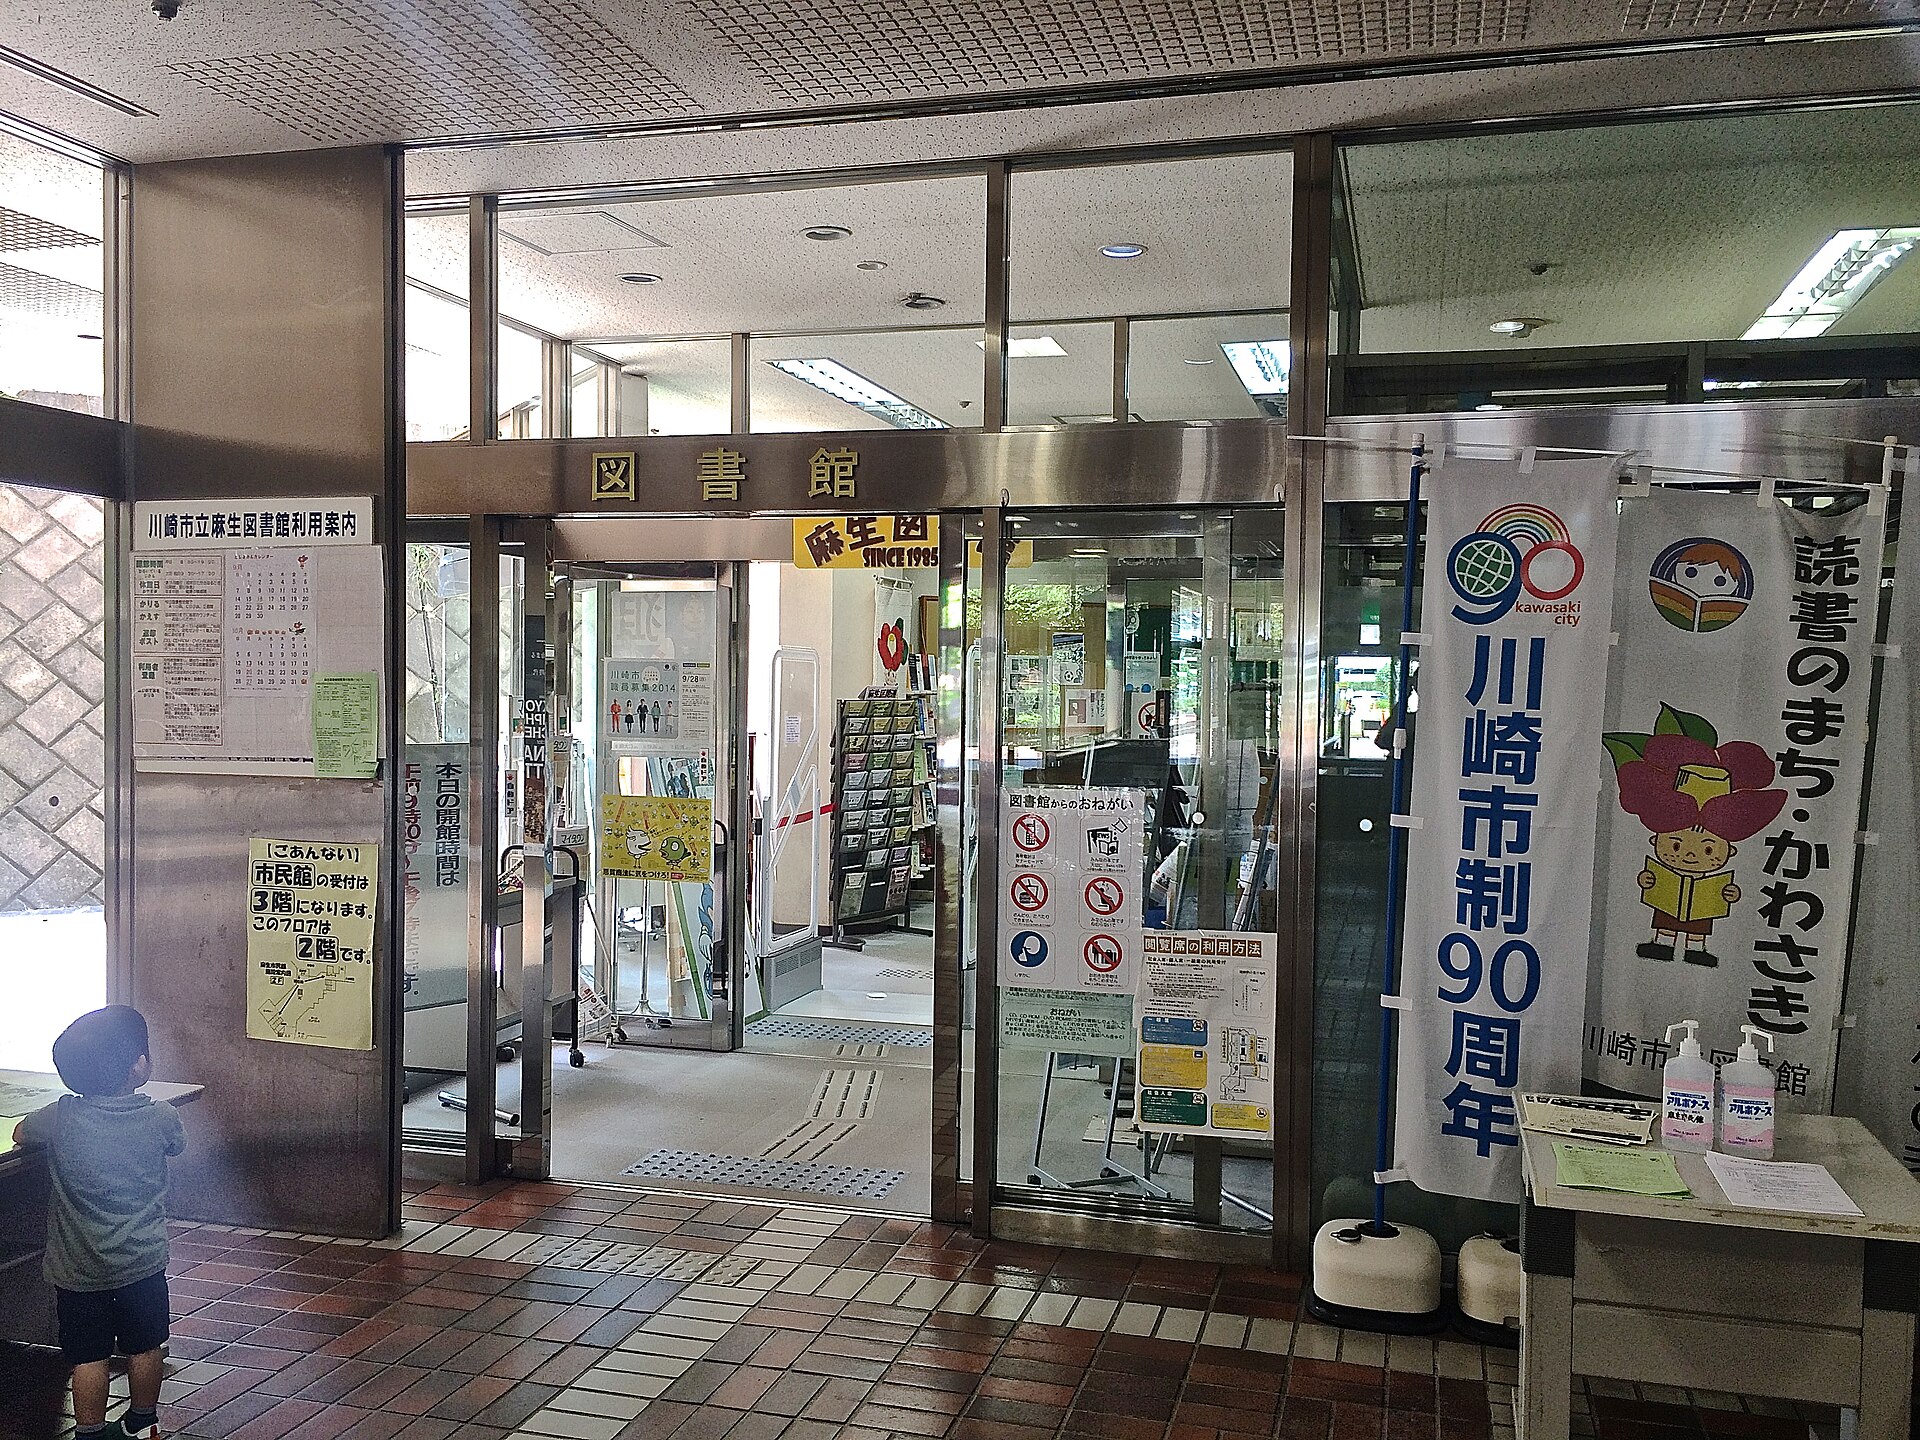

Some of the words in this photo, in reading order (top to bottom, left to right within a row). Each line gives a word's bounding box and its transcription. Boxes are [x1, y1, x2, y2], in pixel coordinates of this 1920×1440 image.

[591, 446, 858, 502] 図書館
[148, 510, 357, 540] 川崎市立麻生図書館利用案内
[862, 547, 905, 568] SINCE
[906, 546, 939, 568] 1985
[139, 600, 160, 608] かりる
[1515, 600, 1581, 613] kawasaki
[139, 612, 160, 621] かえす
[1554, 613, 1581, 628] city
[610, 670, 640, 680] 川崎市
[682, 675, 699, 683] 9/28
[610, 682, 676, 693] 職員募集2014
[1746, 534, 1861, 1036] 読書のまち・かわさき
[1009, 794, 1134, 811] 図書館からのおねがい
[435, 762, 463, 887] 本日の開館時間は
[561, 833, 584, 844] マイタウン
[255, 863, 370, 891] 市民館の受付は
[252, 891, 373, 920] 3階になります。
[1437, 634, 1546, 1159] 川崎市制90周年
[252, 916, 332, 935] このフロアは
[298, 937, 372, 965] 2階です。
[1144, 936, 1261, 958] 閲覧席の利用方法
[1049, 1008, 1081, 1017] おねがい
[1582, 1022, 1811, 1097] 川崎市図館
[1666, 1095, 1710, 1111] アルボナース
[1728, 1103, 1773, 1117] アルボナース
